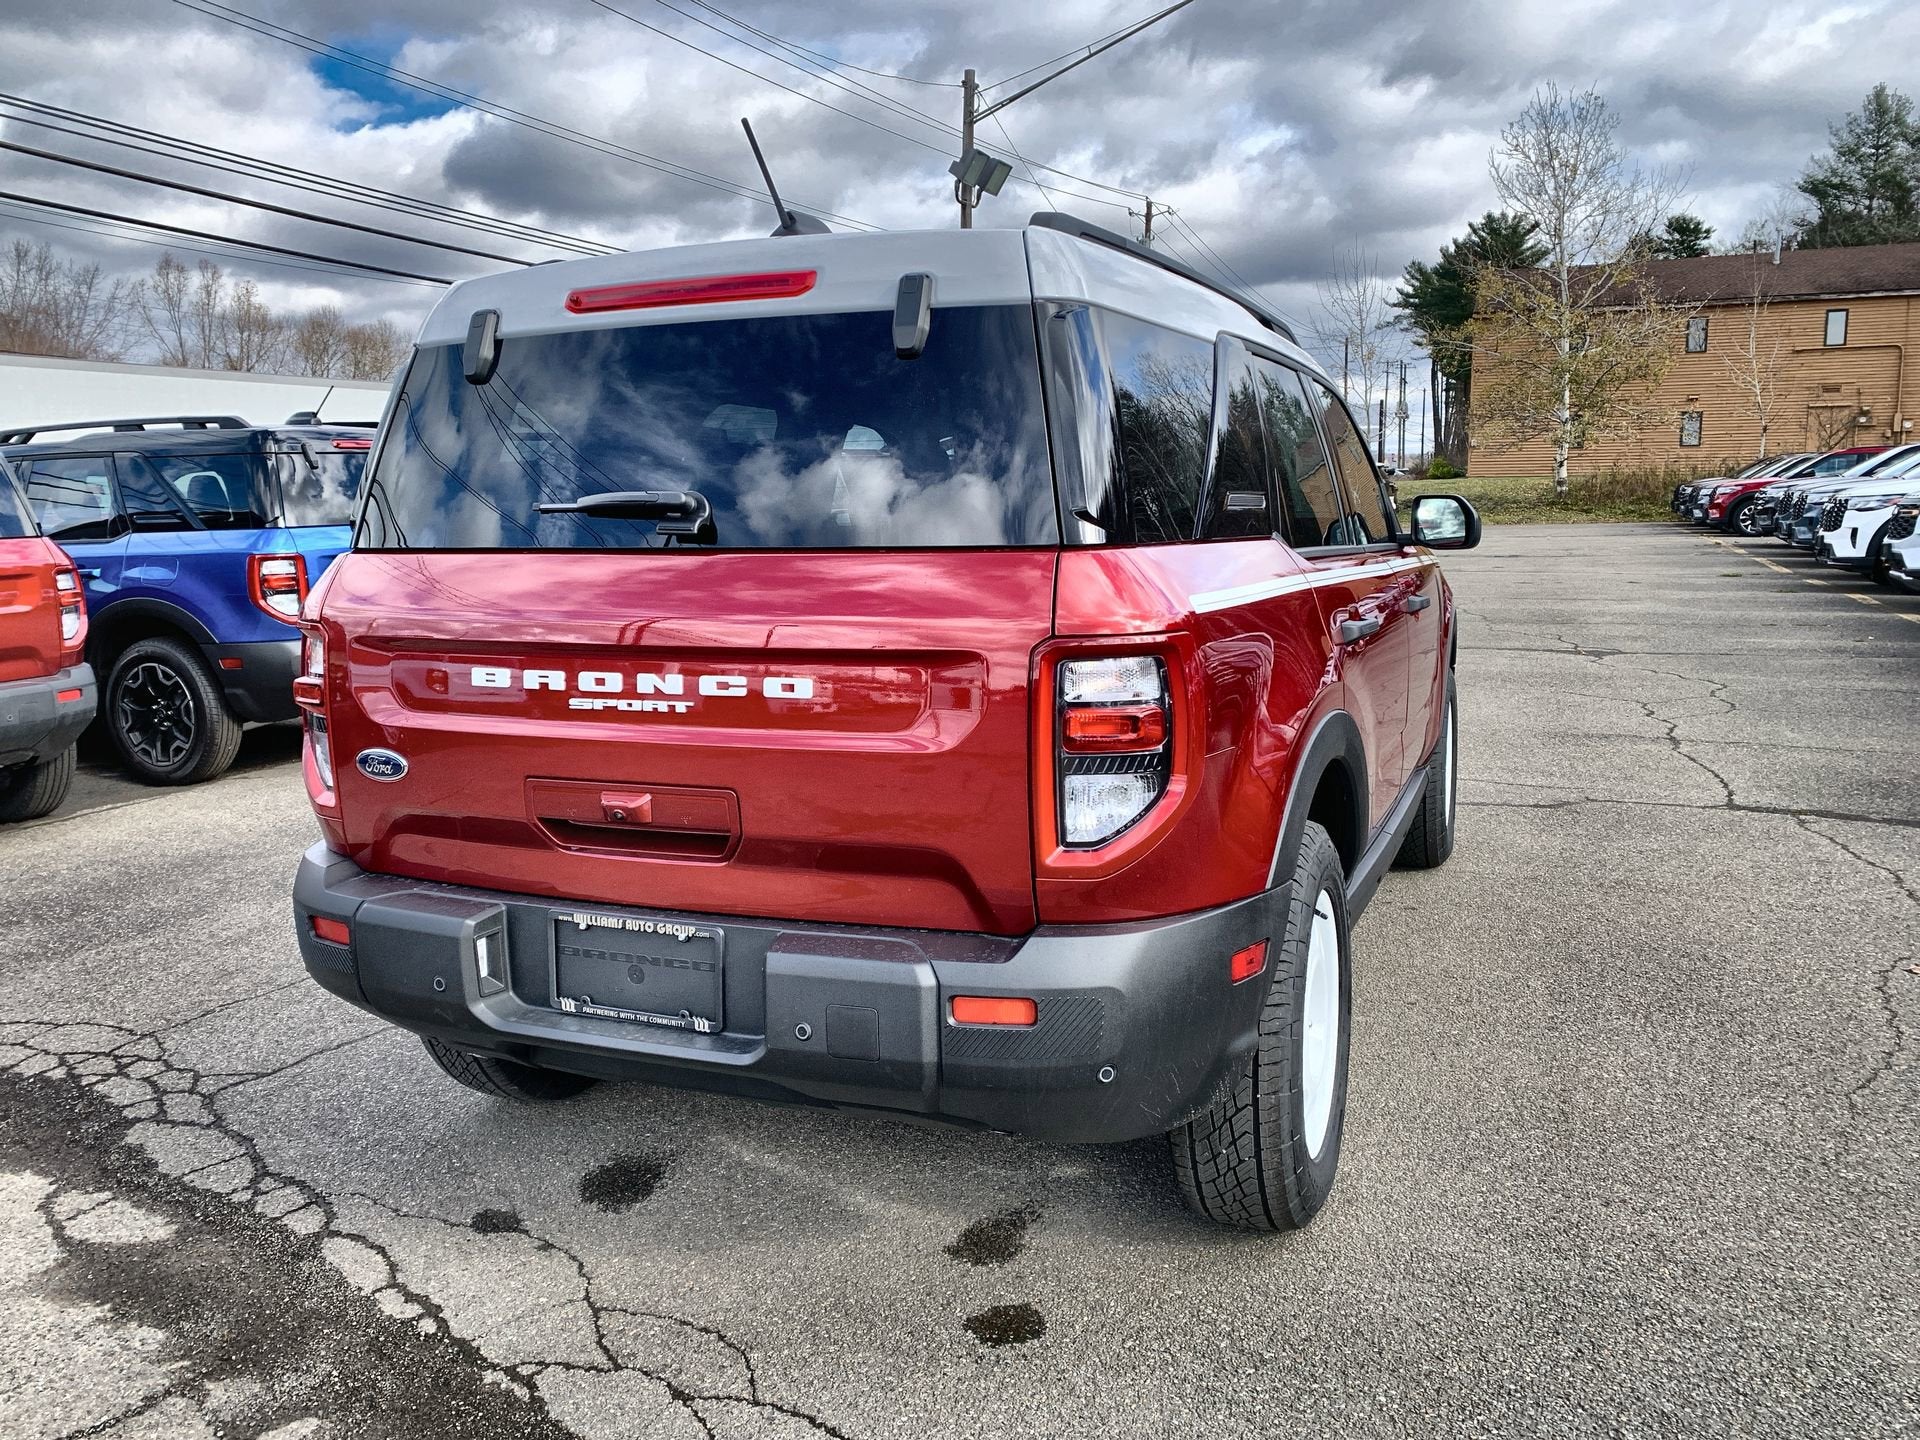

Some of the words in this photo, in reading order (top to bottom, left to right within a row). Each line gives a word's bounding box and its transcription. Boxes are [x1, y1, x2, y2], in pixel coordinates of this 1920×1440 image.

[471, 666, 814, 699] BRONCO
[568, 697, 695, 713] SPORT
[365, 755, 394, 774] Ford
[625, 920, 653, 933] AUTO
[557, 943, 716, 973] BRONCO
[582, 1006, 619, 1019] PARTNERING
[619, 1010, 636, 1021] WITH
[636, 1013, 649, 1023] THE
[649, 1016, 686, 1028] COMMUNITY
